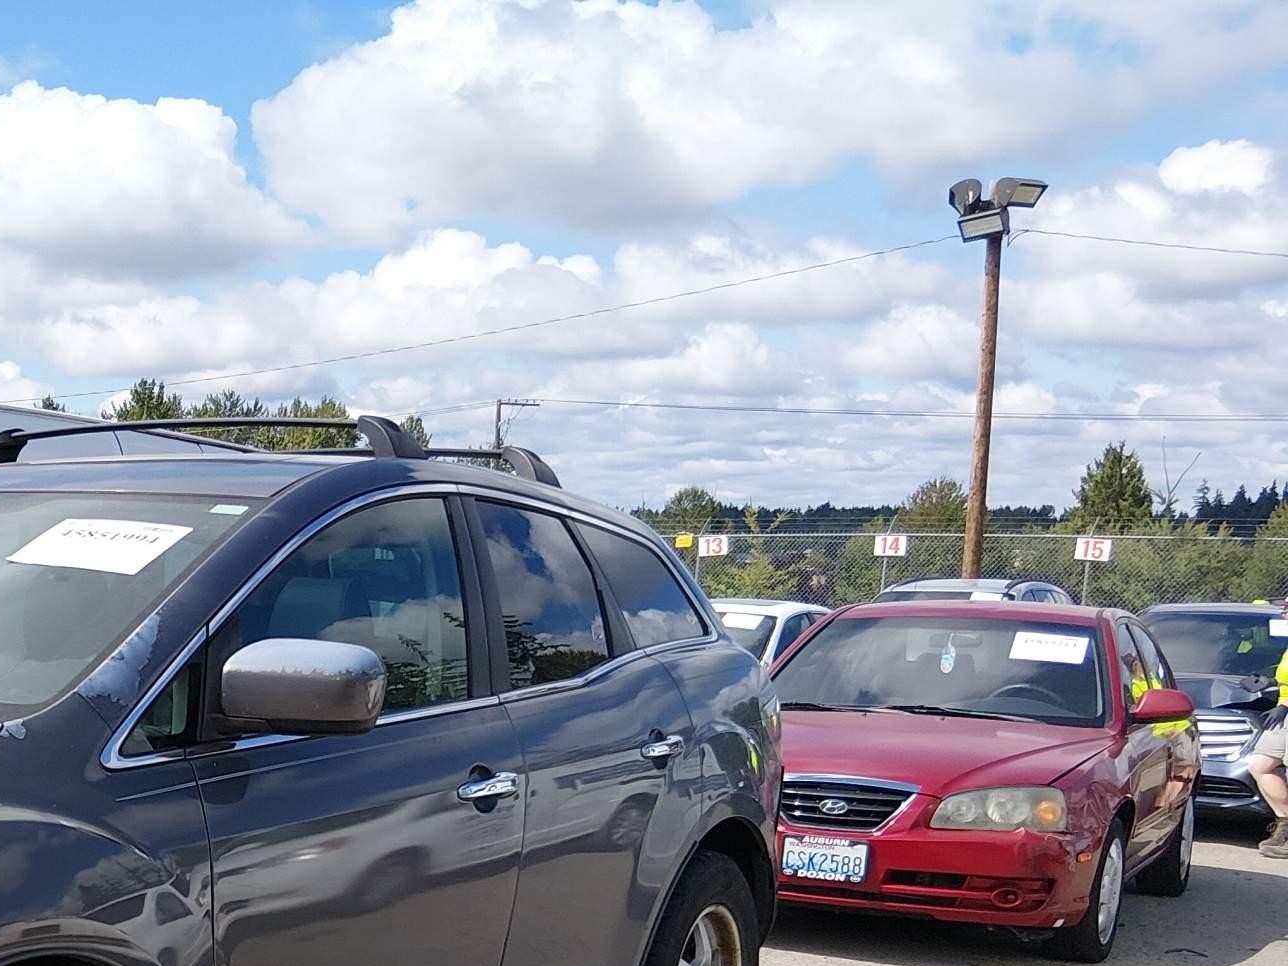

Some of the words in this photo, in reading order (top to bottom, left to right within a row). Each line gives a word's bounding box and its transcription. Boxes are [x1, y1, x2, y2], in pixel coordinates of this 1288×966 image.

[704, 537, 723, 555] 13
[881, 536, 900, 555] 14
[1082, 540, 1105, 560] 15
[802, 836, 850, 847] AUBURN
[786, 850, 863, 876] CSK2588
[797, 869, 847, 882] DOXON
